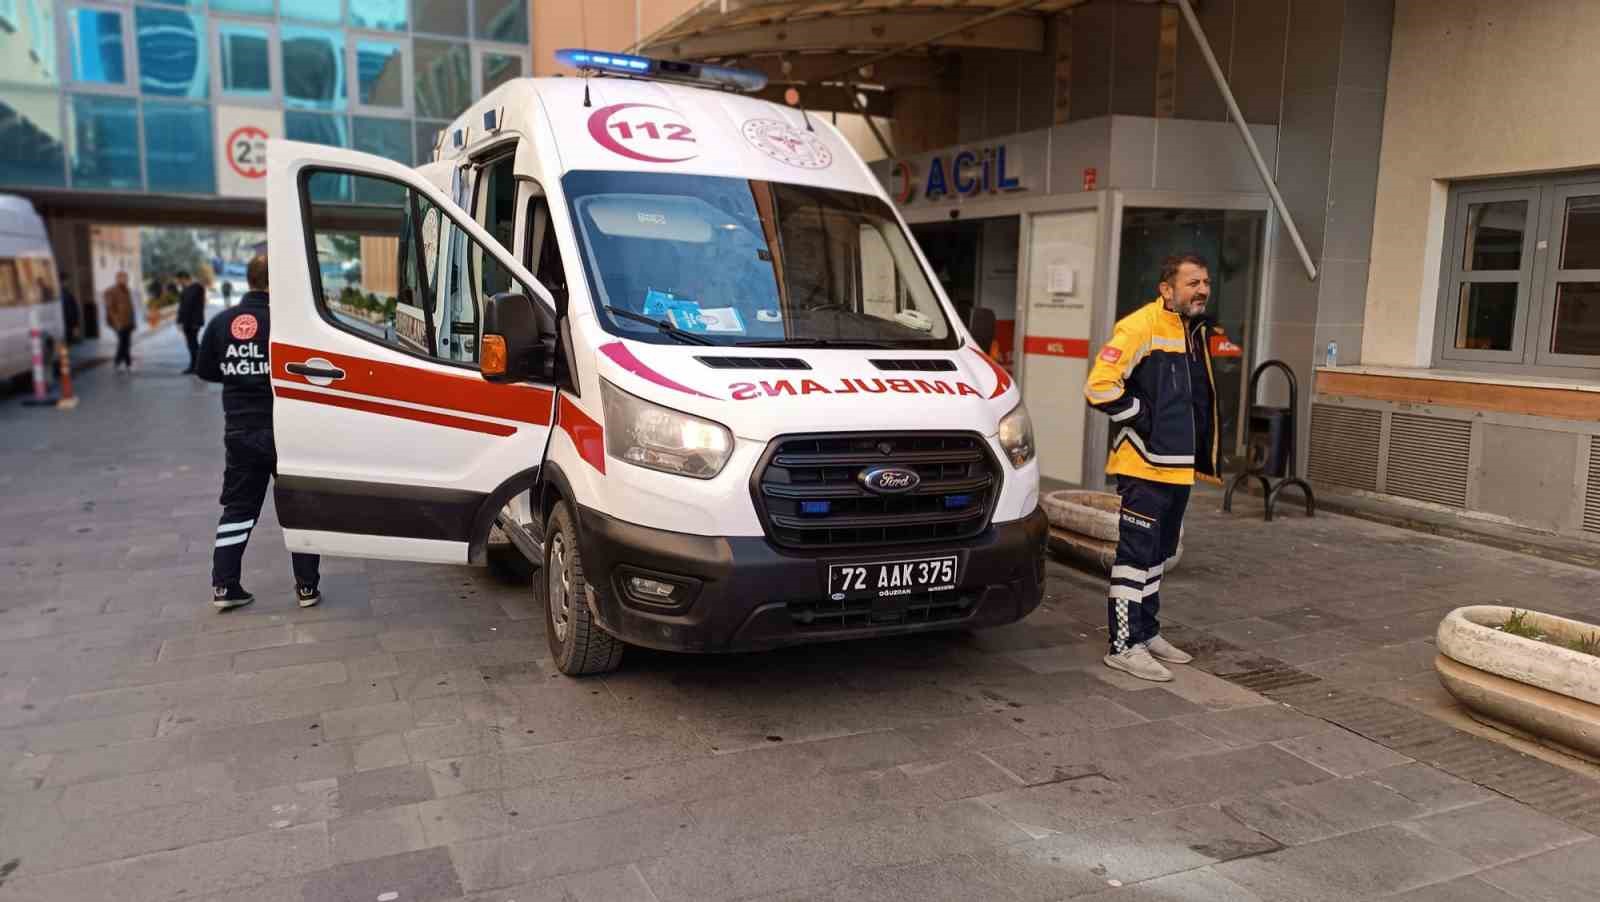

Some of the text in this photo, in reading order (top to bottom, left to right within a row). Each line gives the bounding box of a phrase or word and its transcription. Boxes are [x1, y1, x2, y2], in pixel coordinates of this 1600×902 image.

[608, 121, 697, 143] 112
[225, 342, 265, 358] ACİL
[879, 471, 910, 488] Ford
[841, 560, 954, 591] 72 AAK 375
